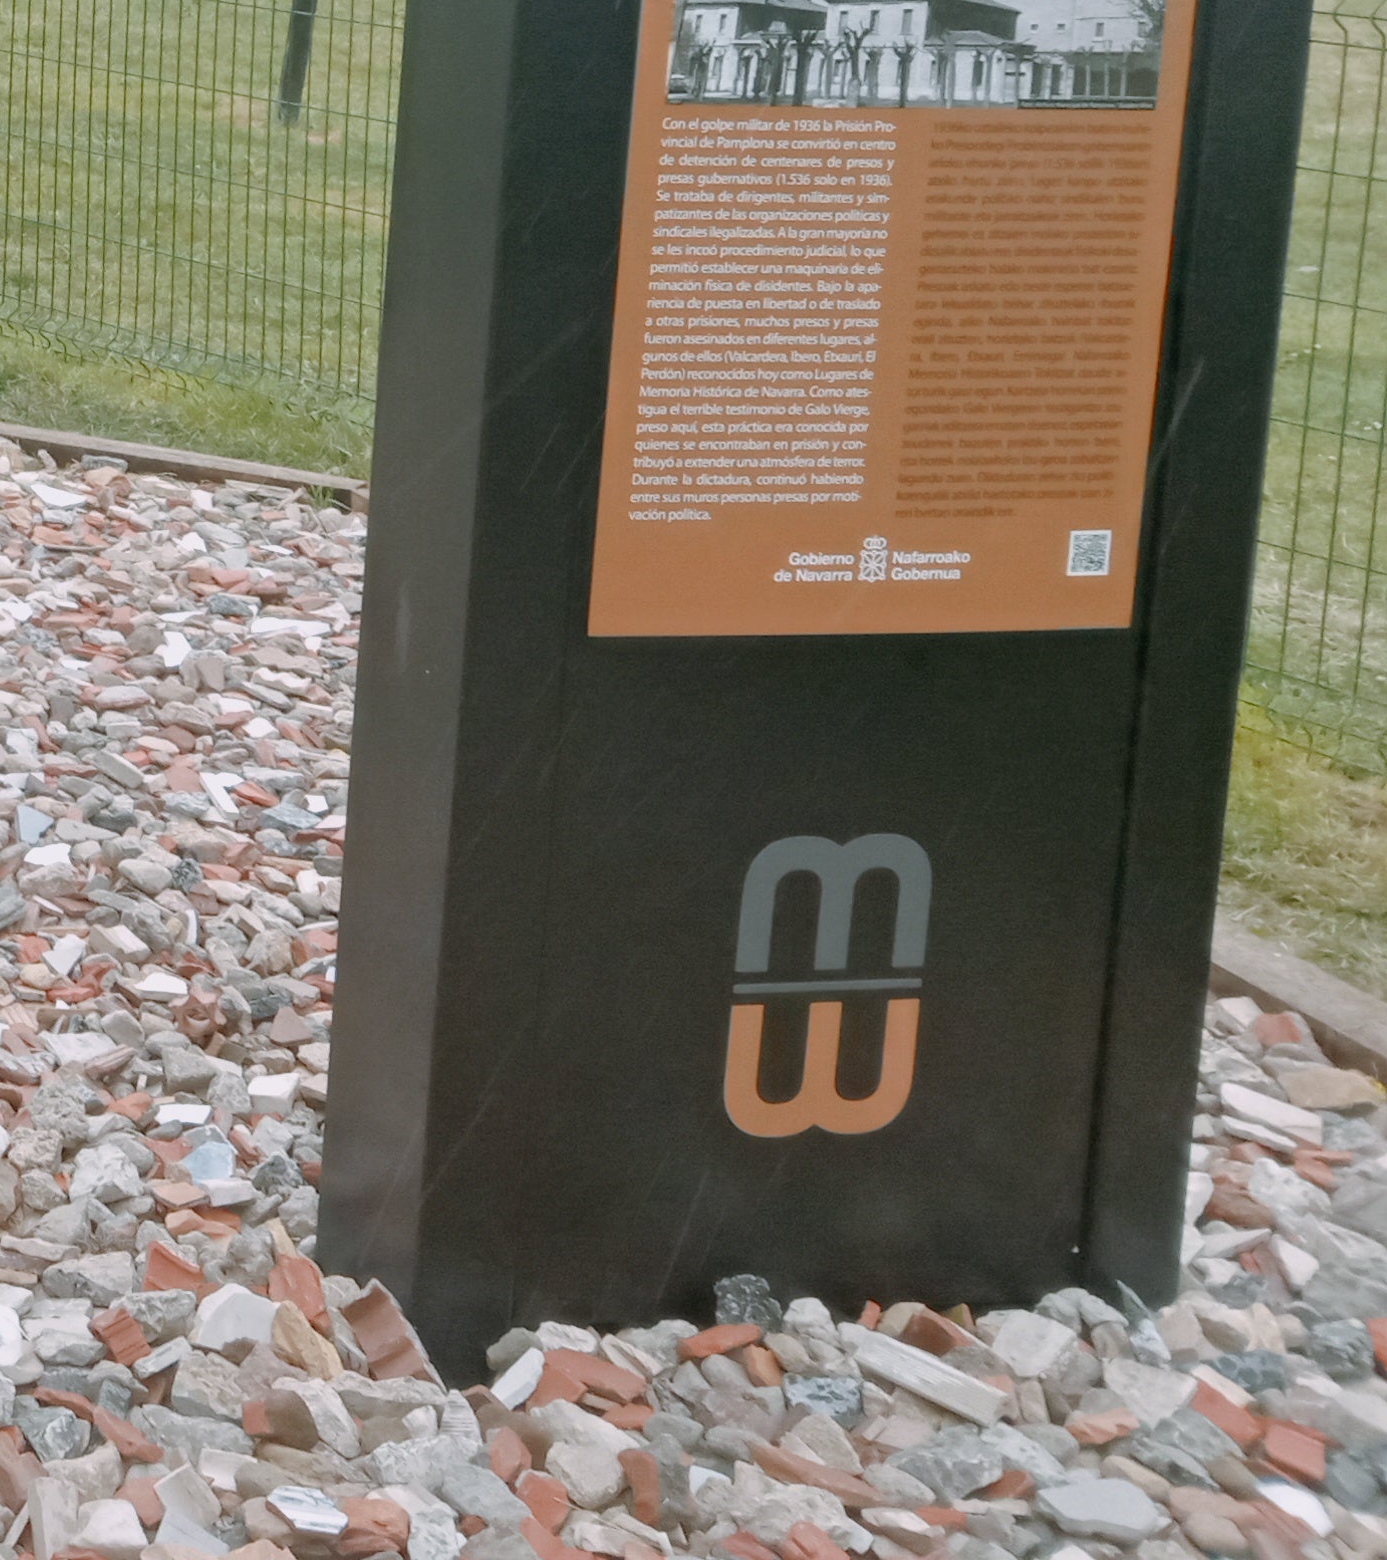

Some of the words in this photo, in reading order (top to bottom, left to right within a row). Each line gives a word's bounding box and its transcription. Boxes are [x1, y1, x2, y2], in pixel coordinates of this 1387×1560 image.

[662, 117, 685, 129] Con
[688, 118, 699, 129] el
[775, 119, 790, 130] de
[823, 120, 832, 131] la
[659, 154, 674, 165] de
[741, 155, 756, 166] de
[827, 156, 841, 167] de
[887, 160, 894, 170] y
[841, 176, 855, 185] en
[656, 190, 670, 201] Se
[717, 191, 733, 202] de
[856, 195, 863, 205] y
[714, 208, 730, 219] de
[731, 208, 746, 219] las
[881, 213, 889, 223] y
[652, 246, 665, 254] se
[667, 244, 682, 255] les
[850, 245, 861, 256] lo
[863, 248, 885, 258] que
[736, 280, 751, 291] de
[844, 280, 854, 291] la
[687, 297, 702, 308] de
[745, 300, 760, 308] en
[809, 301, 817, 309] o
[819, 298, 834, 309] de
[788, 551, 854, 567] Gobierno
[892, 549, 971, 565] Nafarroako
[774, 568, 793, 582] de
[796, 567, 853, 582] Navarra
[891, 566, 961, 582] Gobernua
